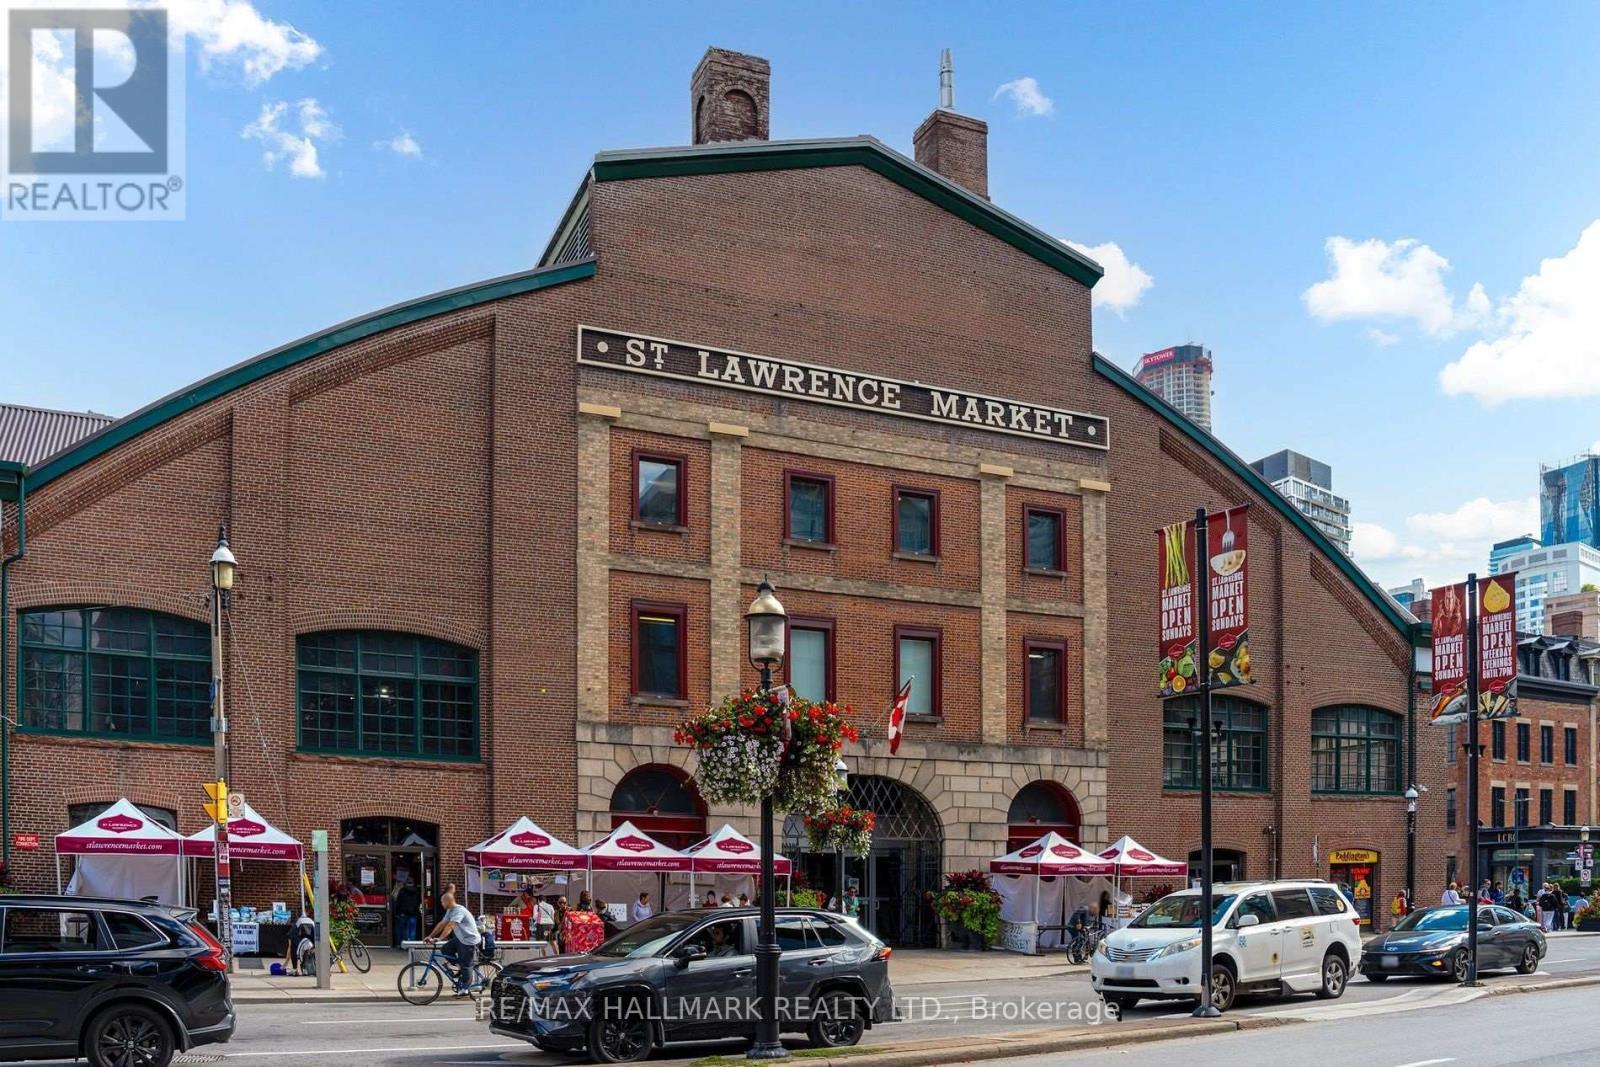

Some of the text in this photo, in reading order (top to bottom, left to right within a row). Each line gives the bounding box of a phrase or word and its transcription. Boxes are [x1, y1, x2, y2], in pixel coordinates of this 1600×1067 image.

[698, 351, 900, 409] LAWRENCE
[930, 391, 1073, 438] MARKET
[1212, 581, 1244, 600] MARKET
[1162, 593, 1191, 611] MARKET
[1212, 595, 1244, 618] OPEN
[1162, 606, 1191, 629] OPEN
[1212, 614, 1244, 631] SUNDAYS
[1162, 625, 1192, 641] SUNDAYS
[1482, 620, 1512, 635] MARKET
[1482, 631, 1512, 650] OPEN
[1434, 642, 1463, 656] MARKET
[1482, 647, 1512, 660] WEEKDAY
[1434, 653, 1463, 670] OPEN
[1482, 656, 1512, 670] EVENINGS
[1434, 668, 1463, 680] SUNDAYS
[1482, 667, 1512, 679] UNTIL 7PM
[86, 841, 163, 850] stlawrencemarket.com
[507, 856, 574, 865] stlawrencemarket.com
